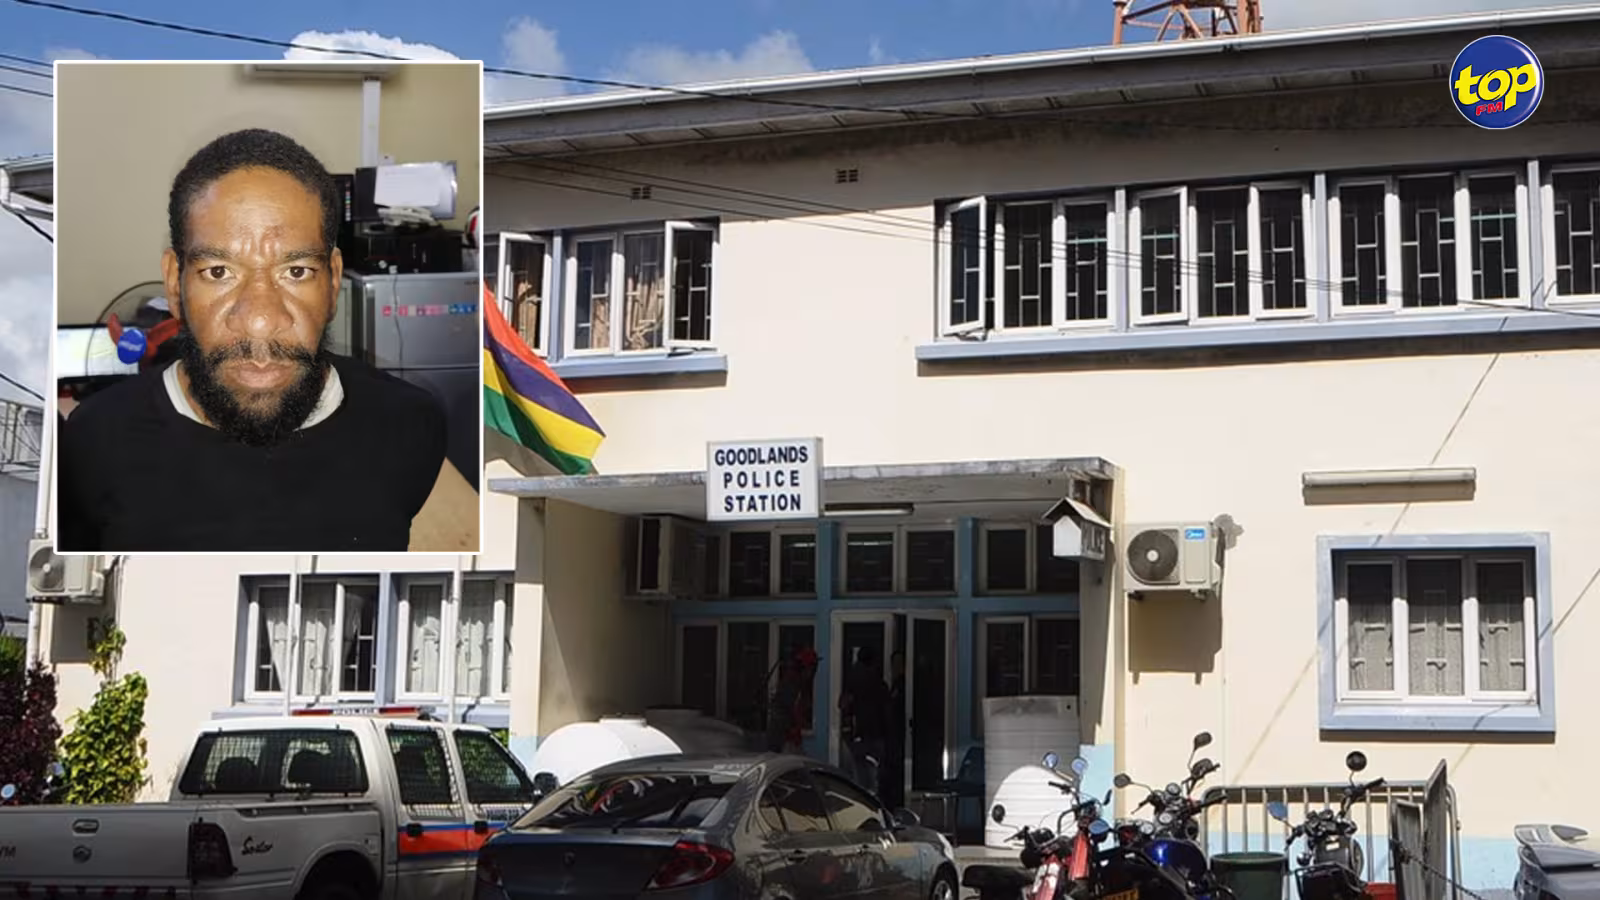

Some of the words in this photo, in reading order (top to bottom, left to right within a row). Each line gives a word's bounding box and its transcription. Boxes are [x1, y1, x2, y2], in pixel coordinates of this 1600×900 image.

[714, 445, 809, 467] GOODLANDS
[723, 469, 800, 489] POLICE
[723, 493, 801, 513] STATION
